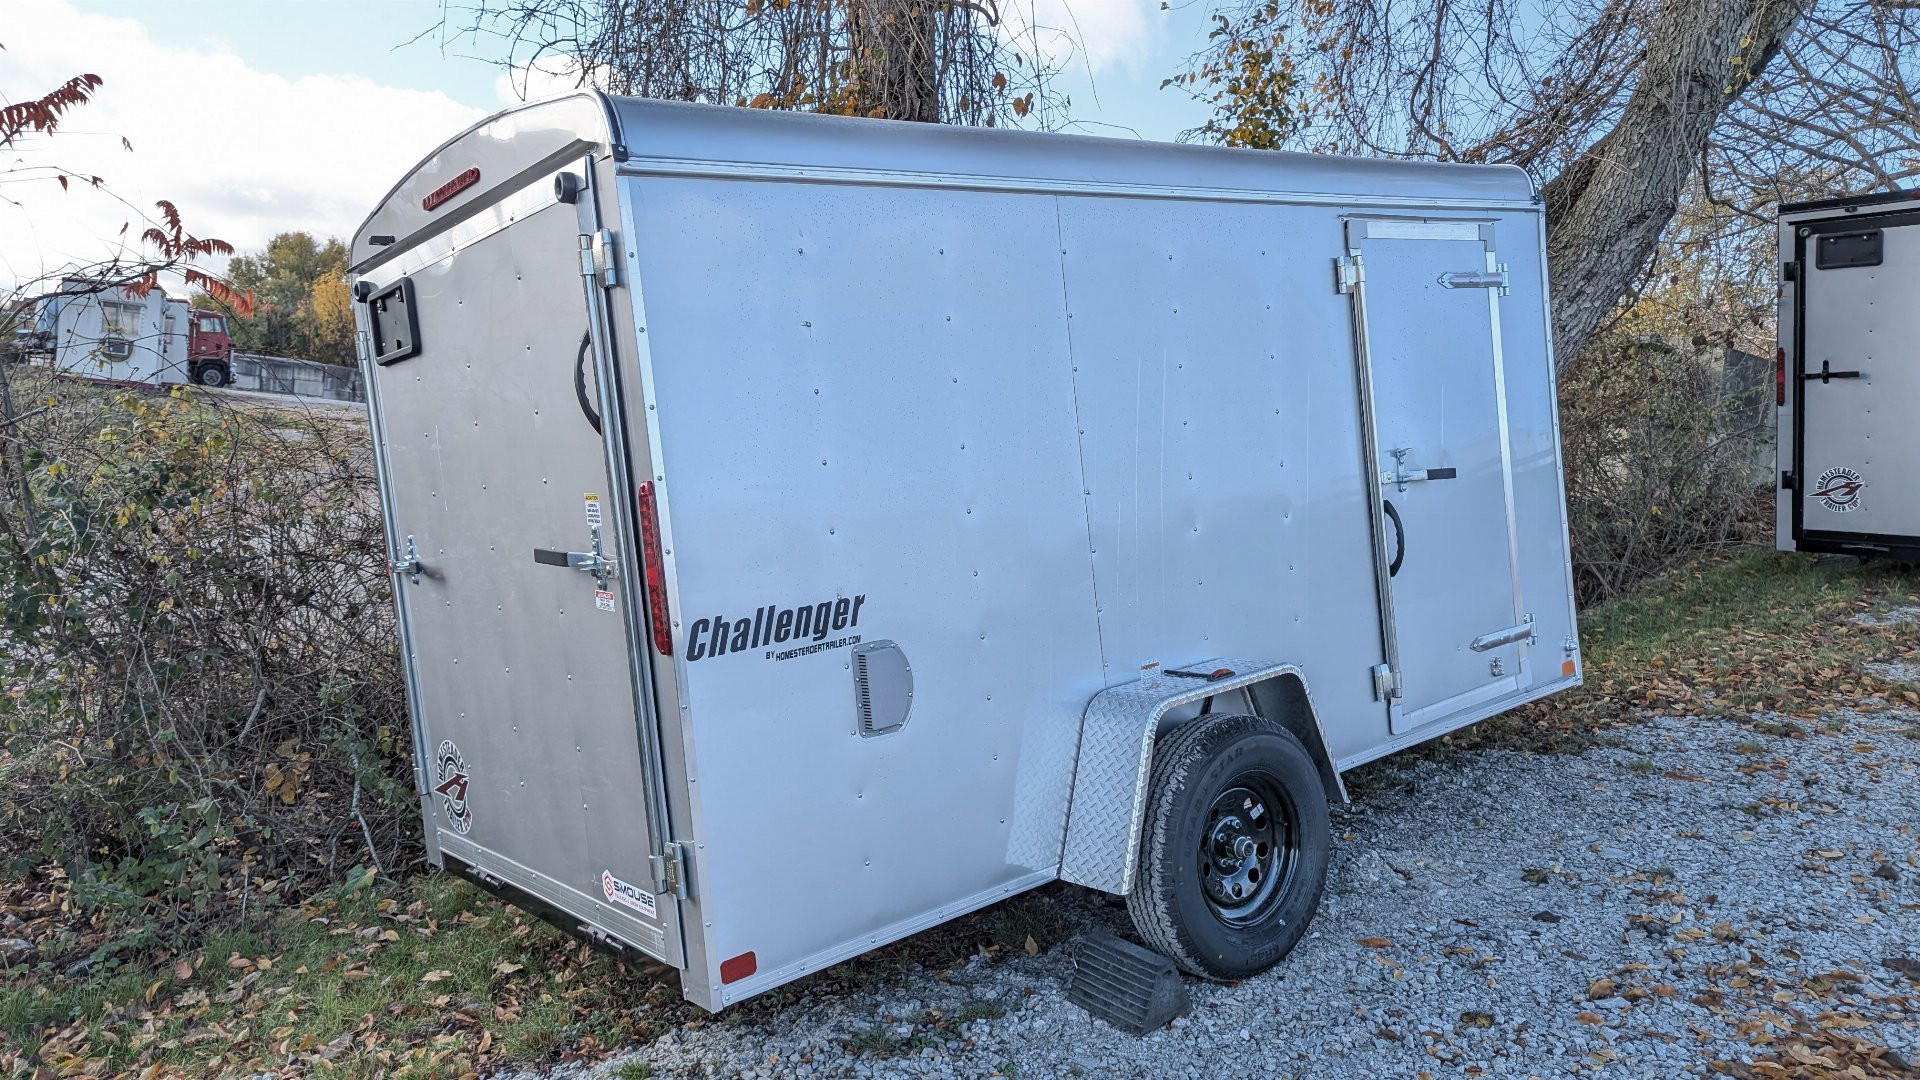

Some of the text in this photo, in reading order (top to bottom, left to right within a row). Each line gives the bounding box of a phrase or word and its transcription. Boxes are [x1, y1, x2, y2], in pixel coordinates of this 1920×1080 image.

[1817, 467, 1860, 490] HOMESTEADER
[685, 593, 866, 662] Challenger
[765, 634, 862, 662] BY HOMESTEADERTRAILER.COM
[613, 880, 654, 908] SMOUSE
